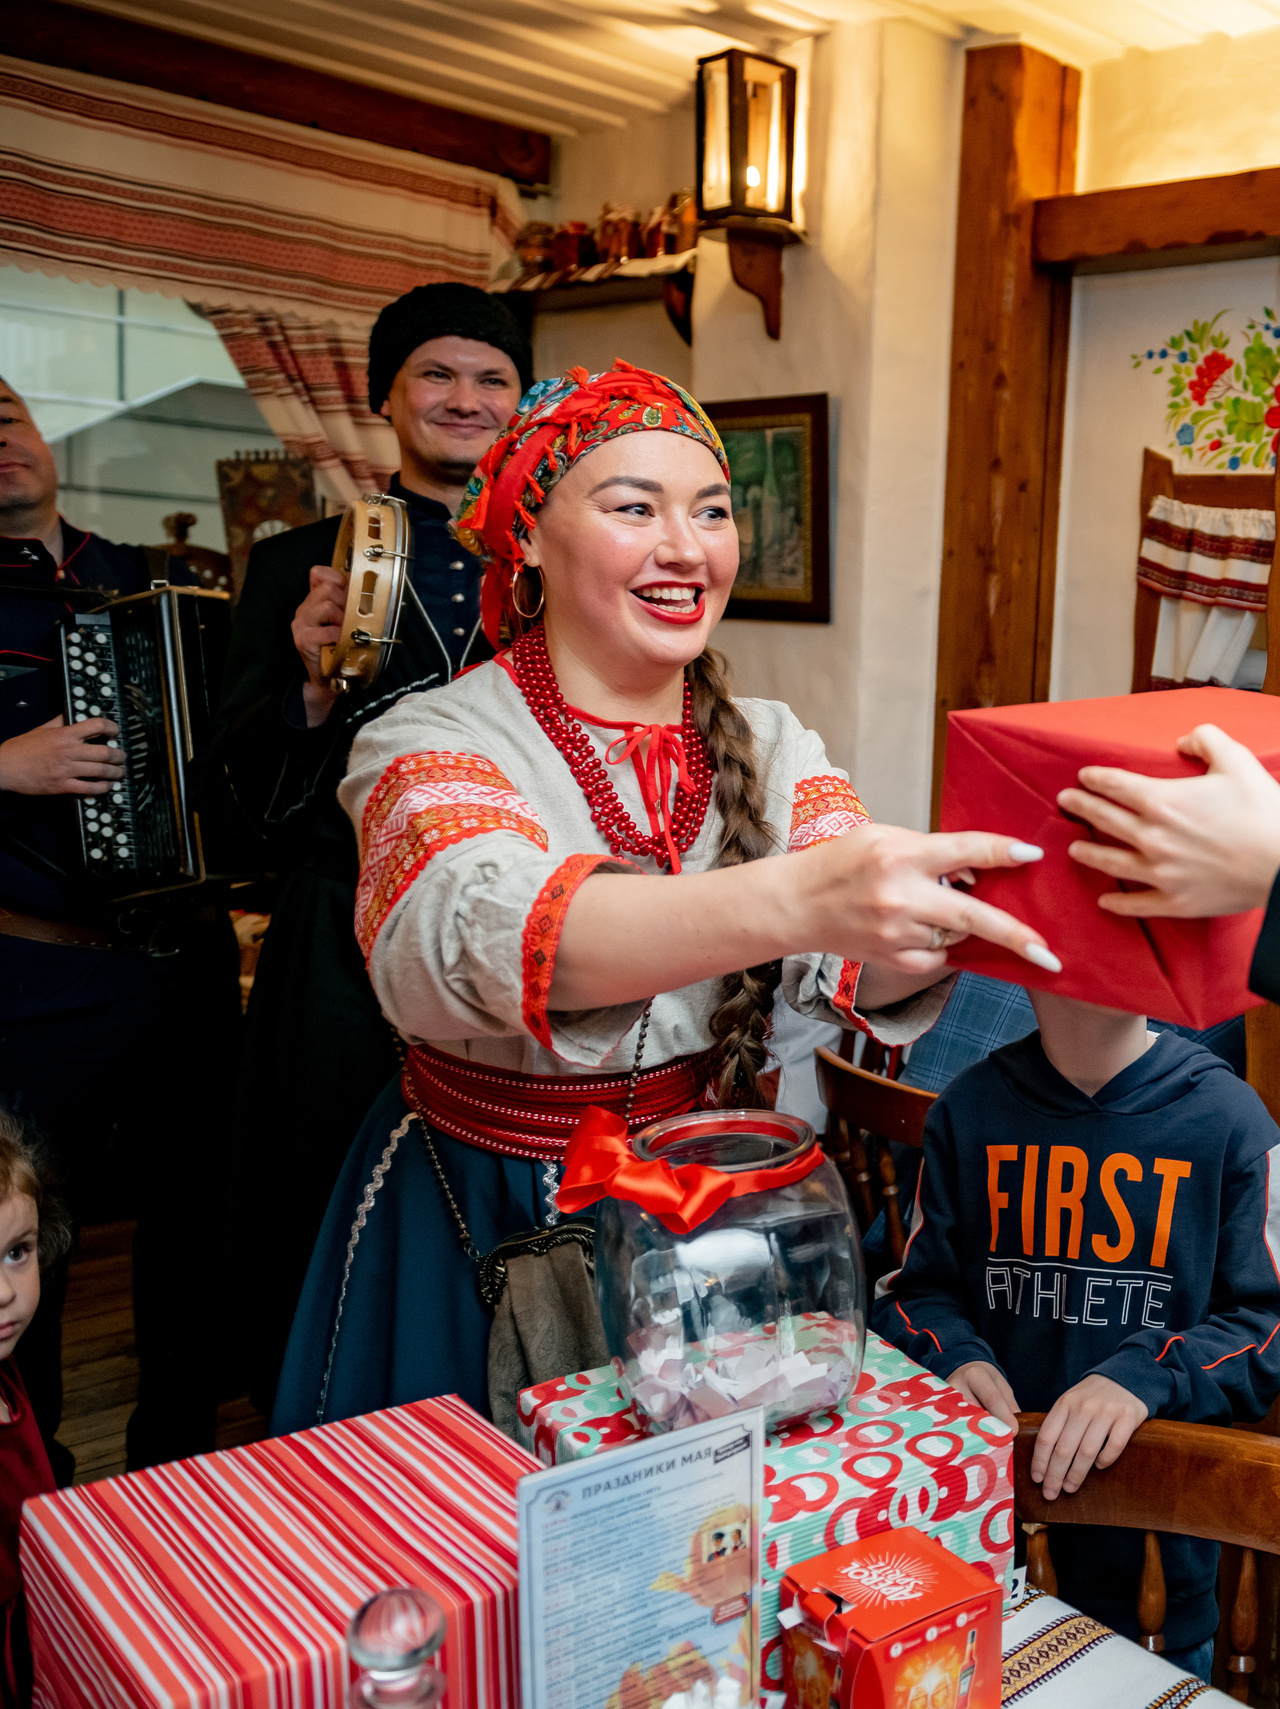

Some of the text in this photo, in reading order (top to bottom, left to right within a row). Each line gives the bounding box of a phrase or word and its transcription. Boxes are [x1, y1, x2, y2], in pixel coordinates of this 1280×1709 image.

[986, 1145, 1192, 1268] FIRST
[986, 1266, 1171, 1328] ATHLETE
[582, 1460, 676, 1500] ПРАЗДНИКИ
[681, 1447, 712, 1467] МАЯ
[840, 1562, 923, 1601] APEROL
[867, 1562, 923, 1589] SPRITZ
